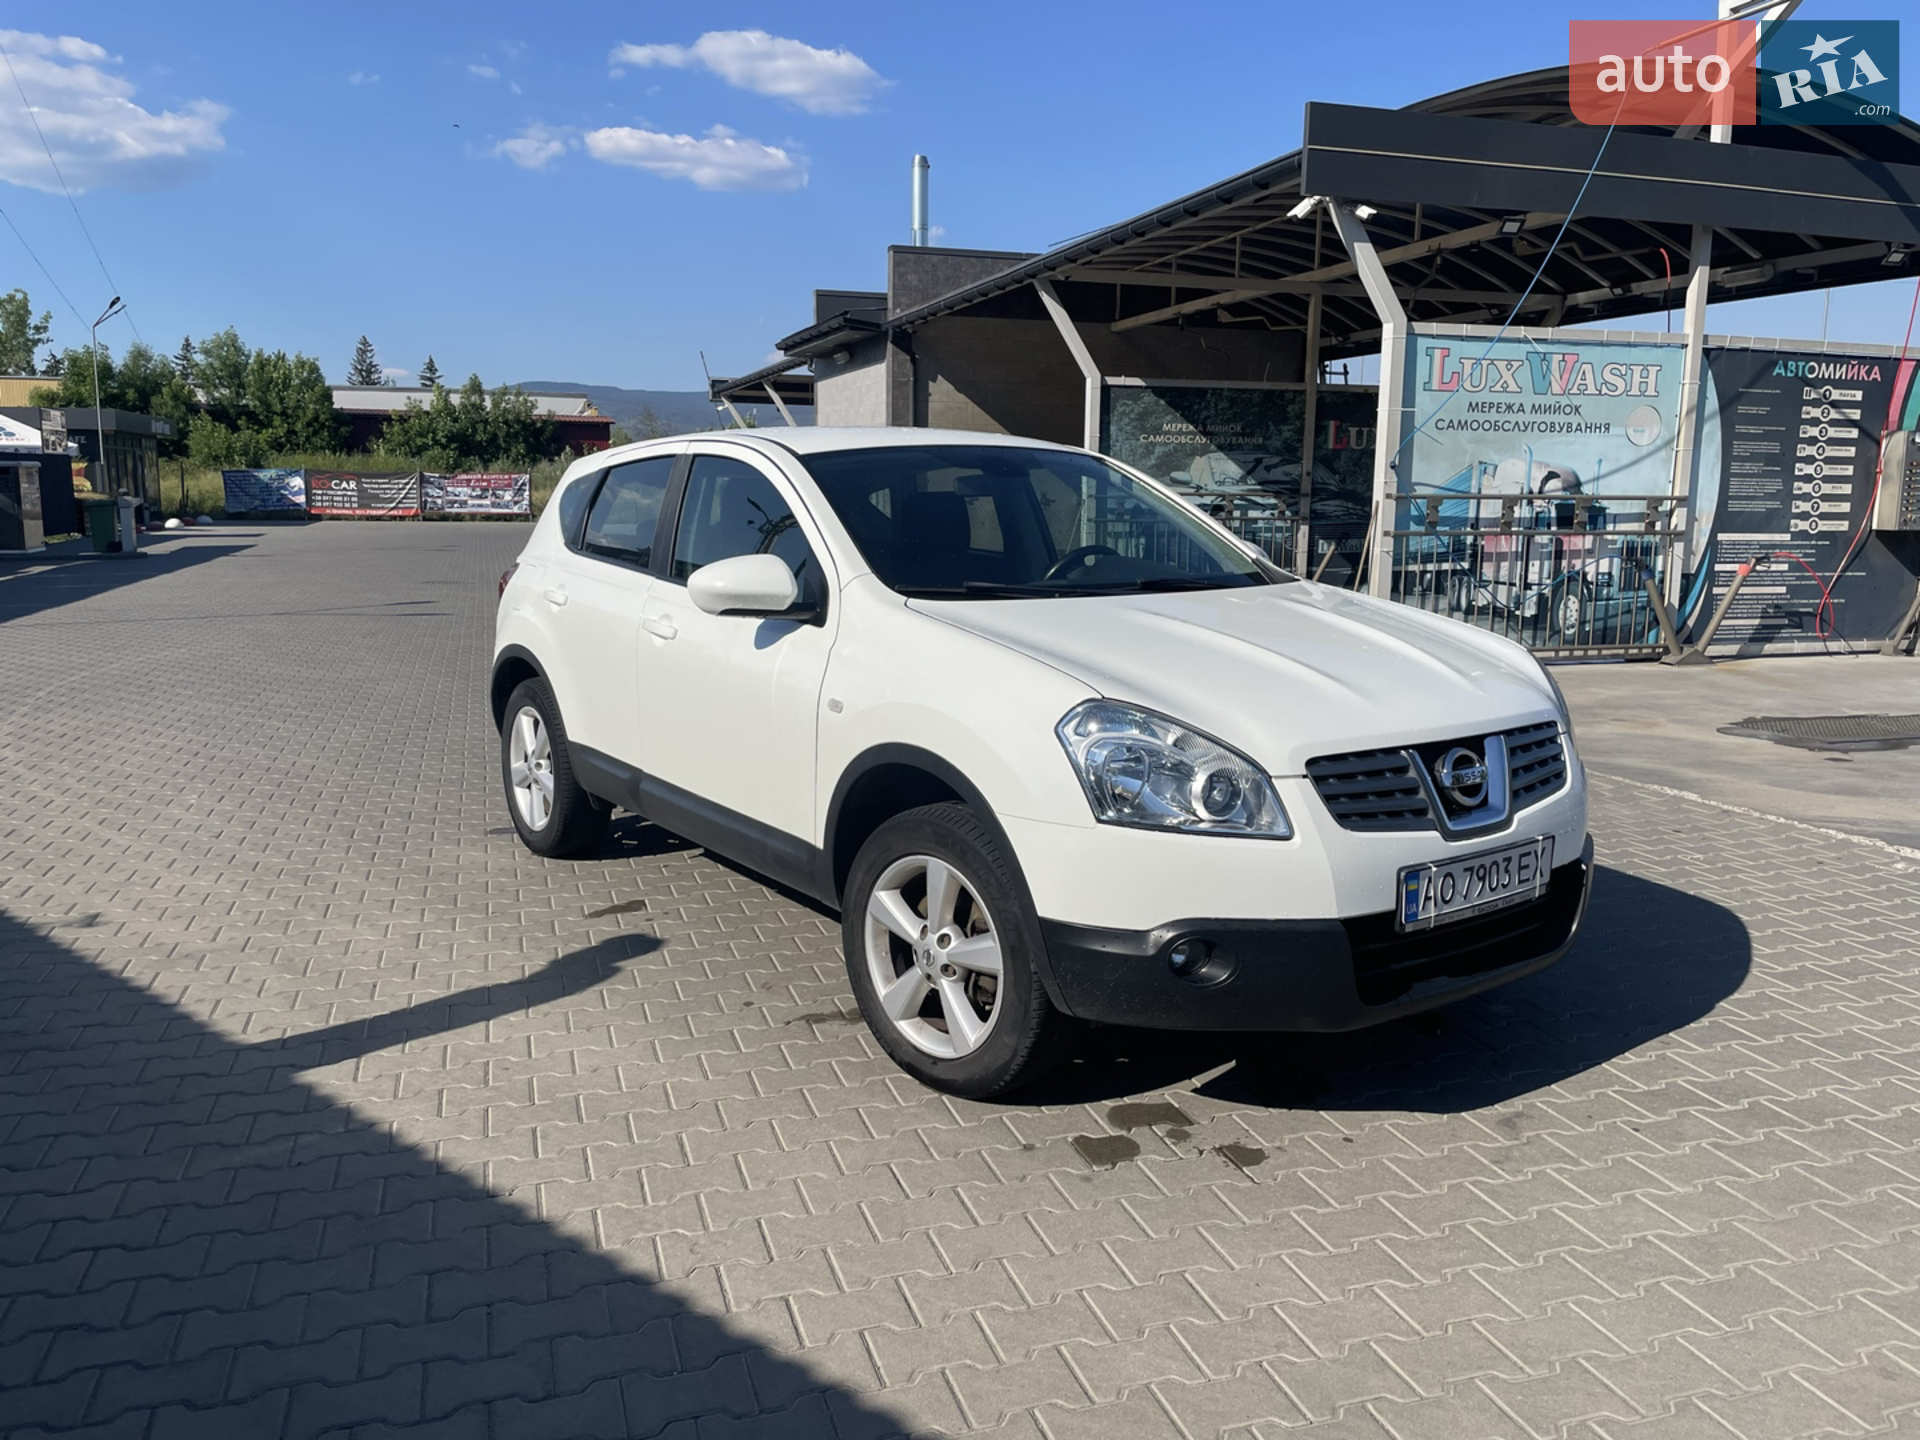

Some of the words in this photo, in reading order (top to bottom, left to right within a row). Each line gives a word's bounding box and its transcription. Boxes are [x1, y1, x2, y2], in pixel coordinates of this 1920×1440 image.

[1773, 360, 1882, 382] АВТОМИЙКА
[1467, 401, 1526, 415] МЕРЕЖА
[1530, 401, 1582, 416] МИЙОК
[1162, 423, 1204, 432] МЕРЕЖА
[1434, 418, 1611, 435] САМООБСЛУГОВУВАННЯ
[1139, 434, 1264, 445] САМООБСЛУГОВУВАННЯ
[312, 479, 357, 490] RO-CAR
[1421, 872, 1455, 912] AO
[1463, 857, 1511, 901] 7903
[1406, 904, 1418, 915] UA
